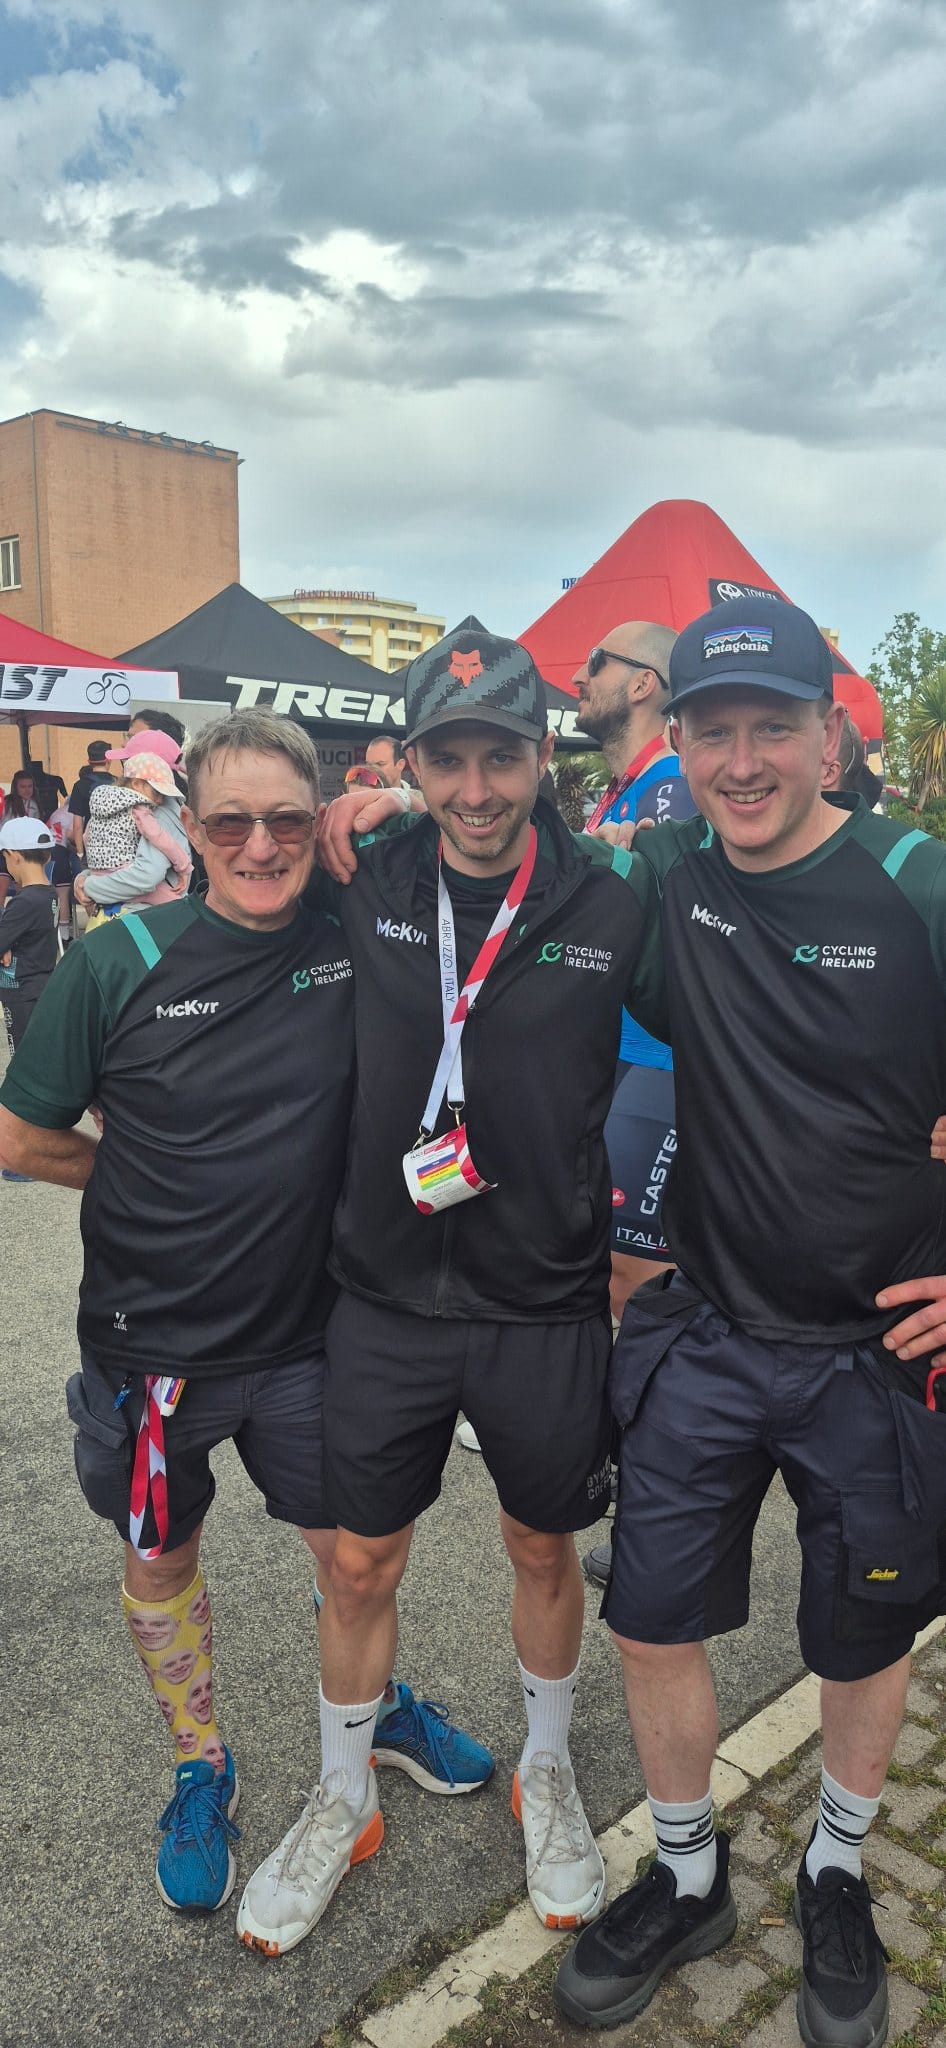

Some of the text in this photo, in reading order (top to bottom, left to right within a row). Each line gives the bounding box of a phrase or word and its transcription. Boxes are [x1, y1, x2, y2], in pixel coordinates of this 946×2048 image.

[705, 641, 769, 659] patagonia
[0, 664, 68, 702] ST
[225, 676, 407, 726] TREK
[565, 944, 613, 961] CYCLING
[821, 945, 878, 957] CYCLING
[310, 958, 352, 976] CYCLING
[441, 918, 457, 1003] ABRUZZO ITALY
[564, 956, 610, 972] IRELAND
[820, 957, 876, 970] IRELAND
[314, 968, 354, 986] IRELAND
[640, 1128, 678, 1215] CASTE
